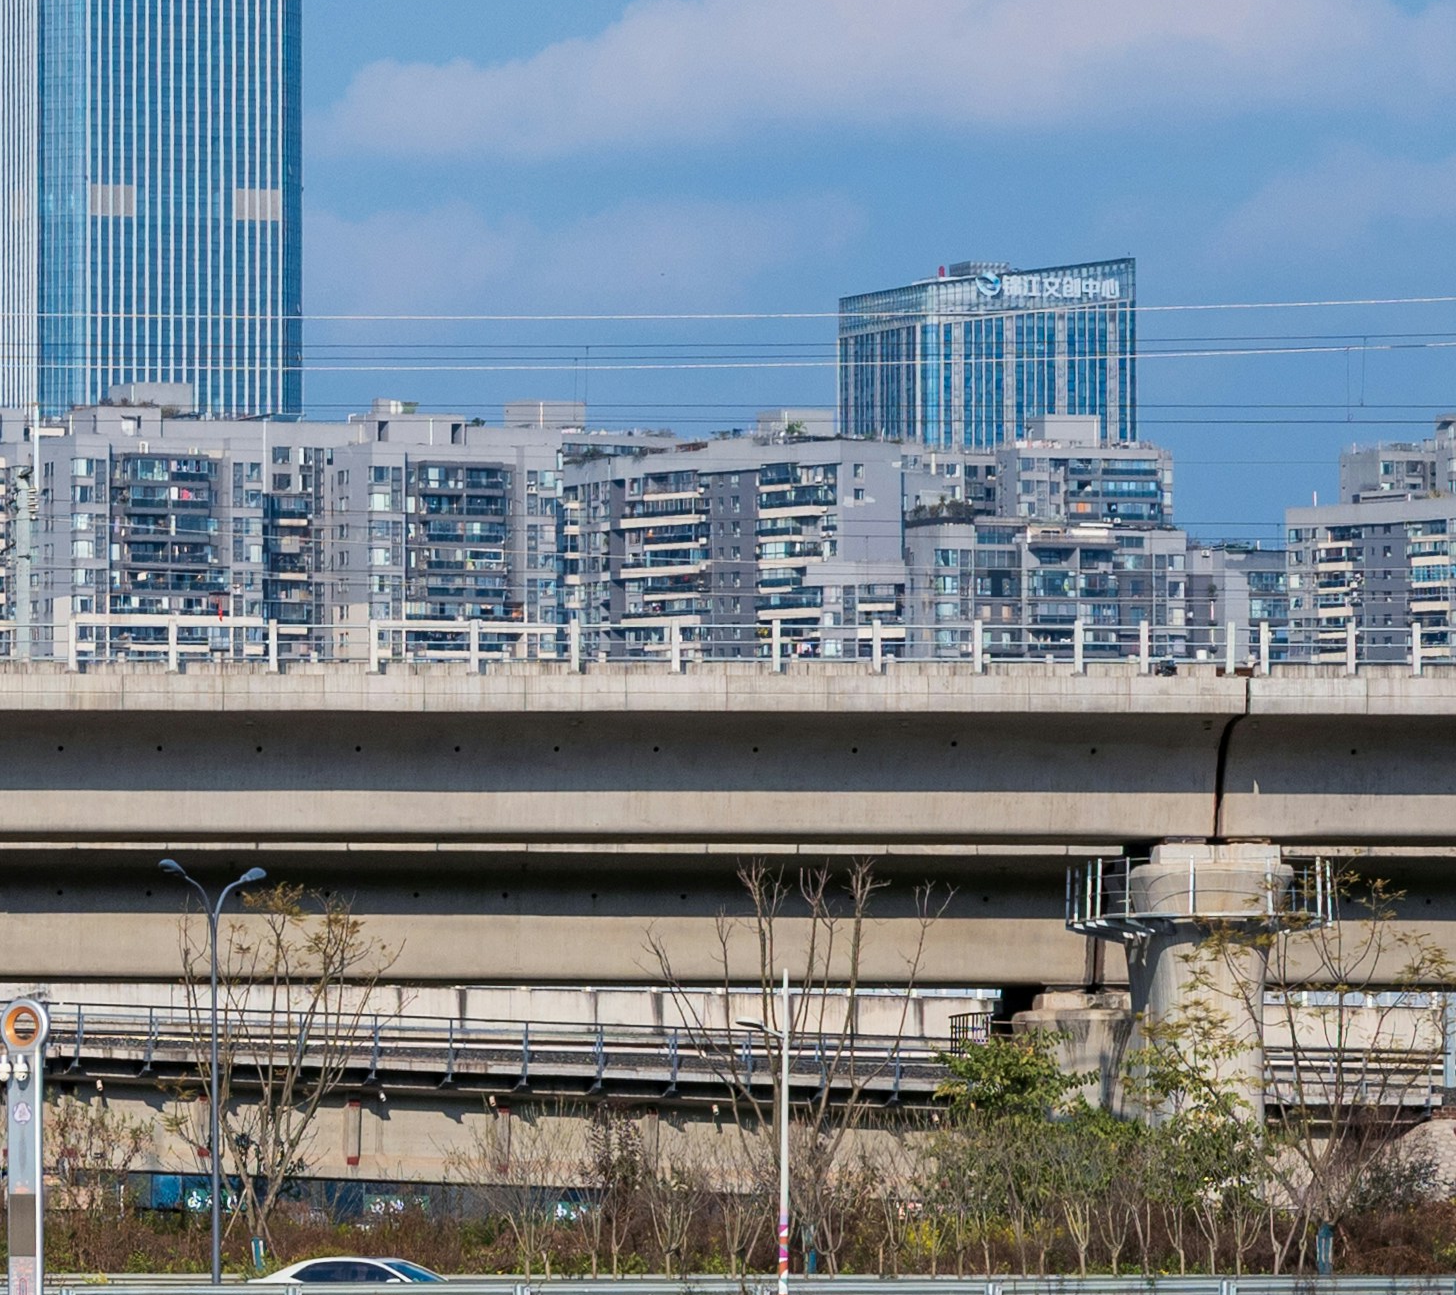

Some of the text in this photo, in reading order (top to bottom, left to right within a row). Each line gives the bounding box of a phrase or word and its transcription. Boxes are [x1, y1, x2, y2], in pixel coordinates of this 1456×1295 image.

[1002, 275, 1119, 298] 锦江文创中心
